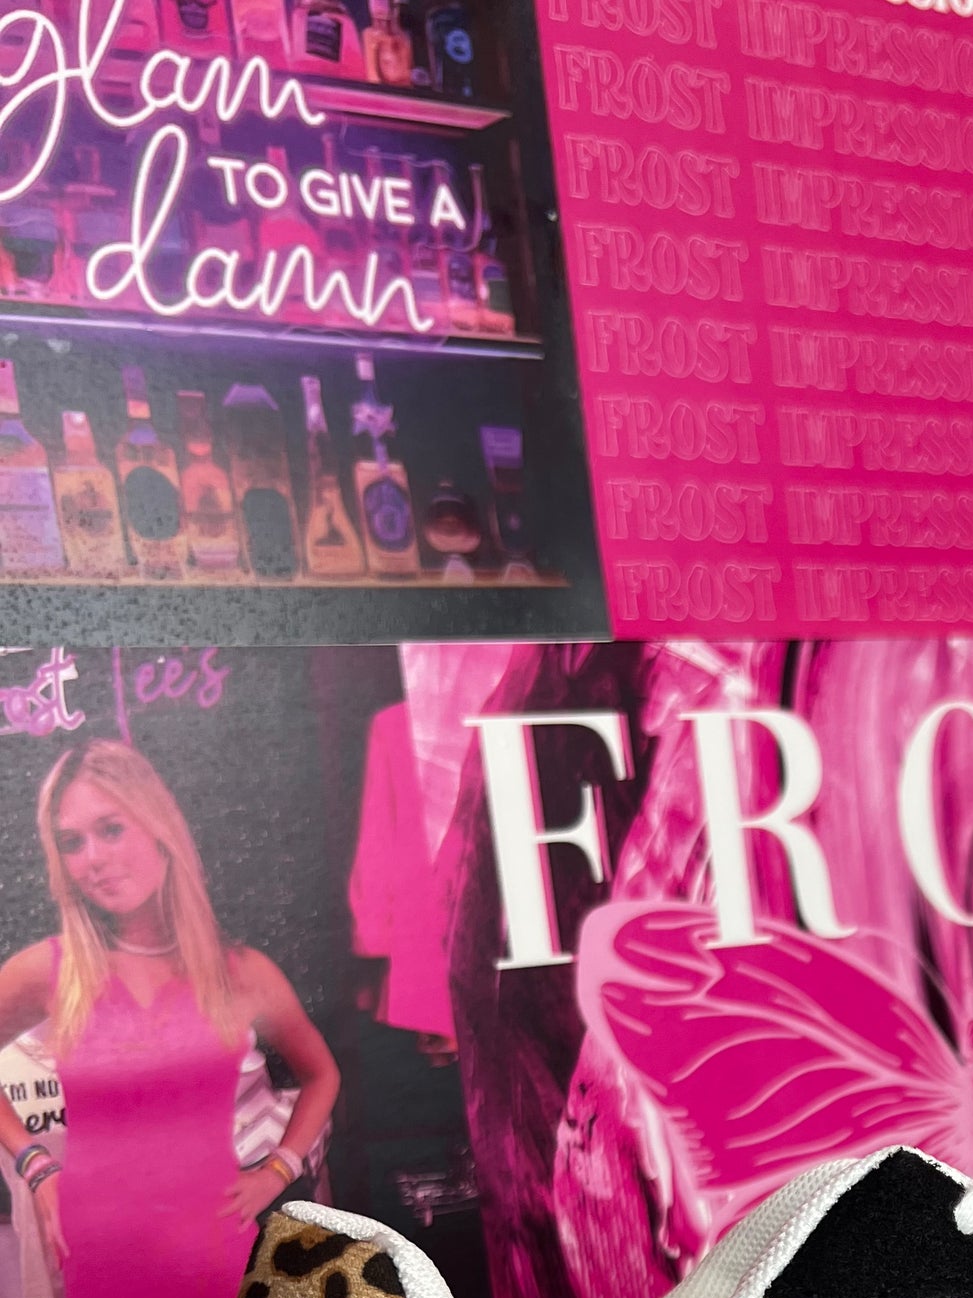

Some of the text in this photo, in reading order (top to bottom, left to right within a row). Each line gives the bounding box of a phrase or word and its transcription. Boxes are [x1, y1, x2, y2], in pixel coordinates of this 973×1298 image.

[0, 0, 325, 200] glam
[553, 43, 731, 134] FROST
[208, 157, 466, 230] TO GIVE A
[564, 132, 740, 219] FROST
[86, 124, 434, 332] damn
[574, 221, 749, 302] FROST
[586, 308, 758, 384] FROST
[600, 395, 765, 464] FROST
[607, 479, 774, 544] FROST
[616, 560, 782, 622] FROST
